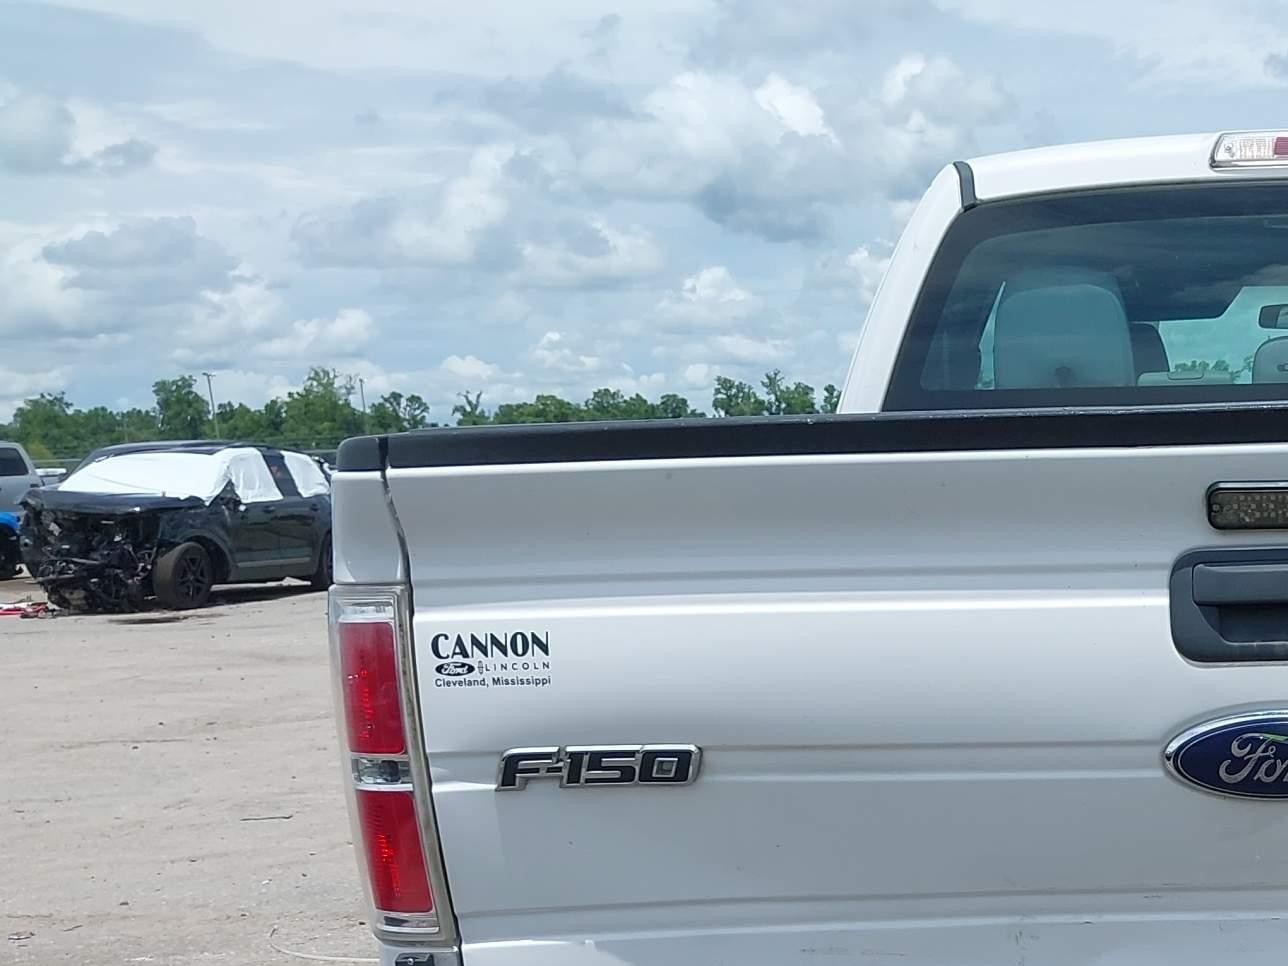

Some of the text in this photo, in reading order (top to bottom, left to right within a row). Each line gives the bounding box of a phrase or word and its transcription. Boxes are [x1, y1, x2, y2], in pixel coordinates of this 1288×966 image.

[431, 631, 549, 659] CANNON
[485, 662, 550, 672] LINCOLN
[435, 676, 551, 687] Cleveland, Mississippi
[497, 744, 702, 791] F-150
